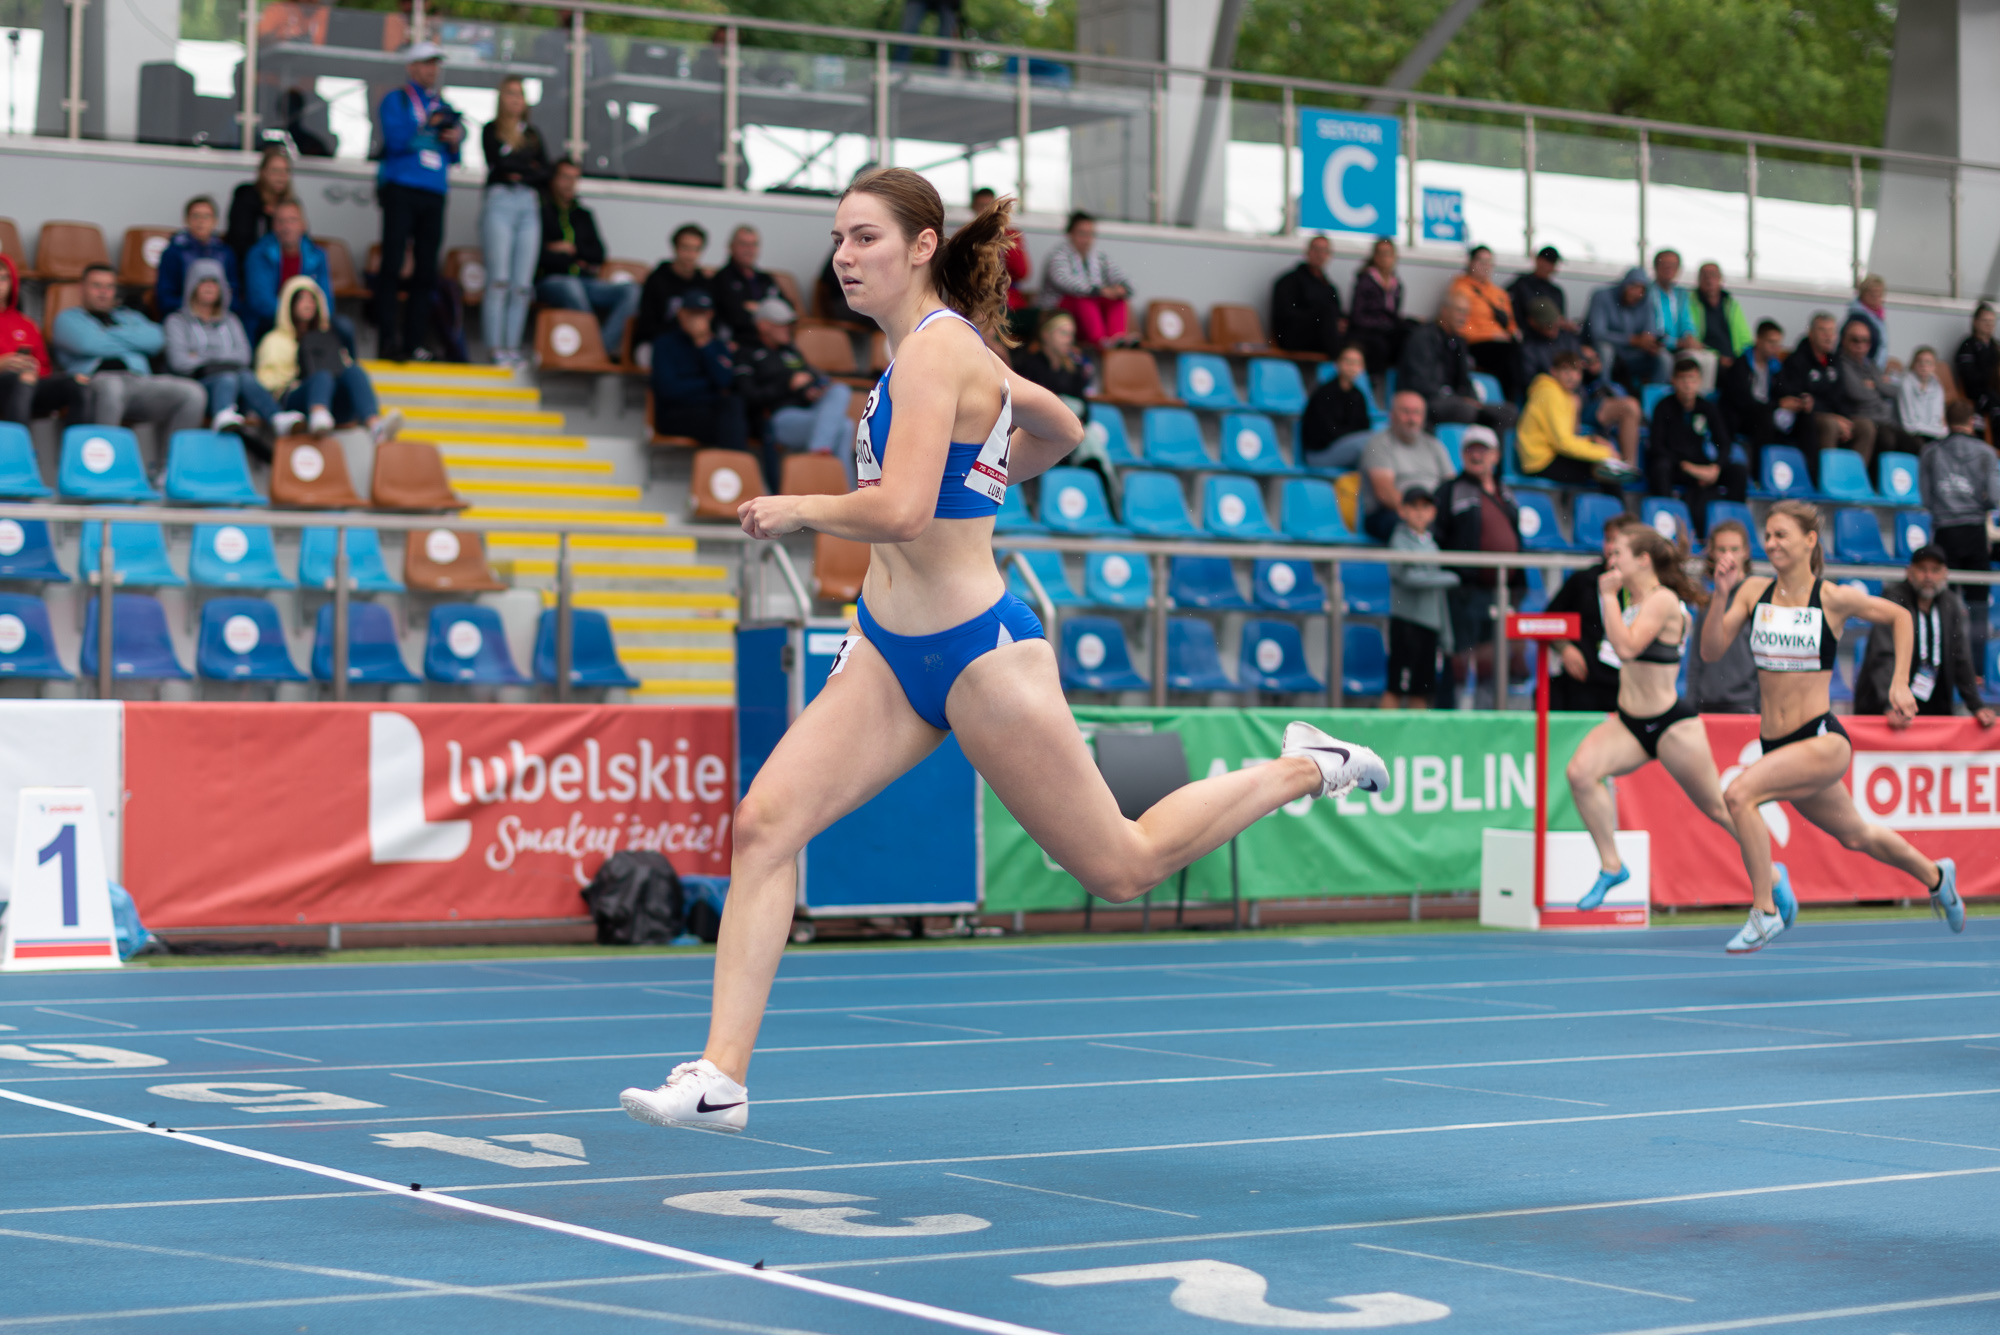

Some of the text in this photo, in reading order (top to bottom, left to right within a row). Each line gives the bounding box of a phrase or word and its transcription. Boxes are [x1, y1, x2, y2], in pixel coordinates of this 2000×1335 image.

[1316, 118, 1383, 144] SEKTOR
[1322, 144, 1378, 229] C
[1425, 193, 1461, 222] WC
[1795, 611, 1812, 624] 28
[1753, 630, 1816, 649] PODWIKA
[38, 824, 79, 927] 1
[146, 1082, 389, 1113] 5
[370, 1131, 590, 1169] 4
[663, 1188, 992, 1237] 3
[1012, 1259, 1452, 1328] 2
